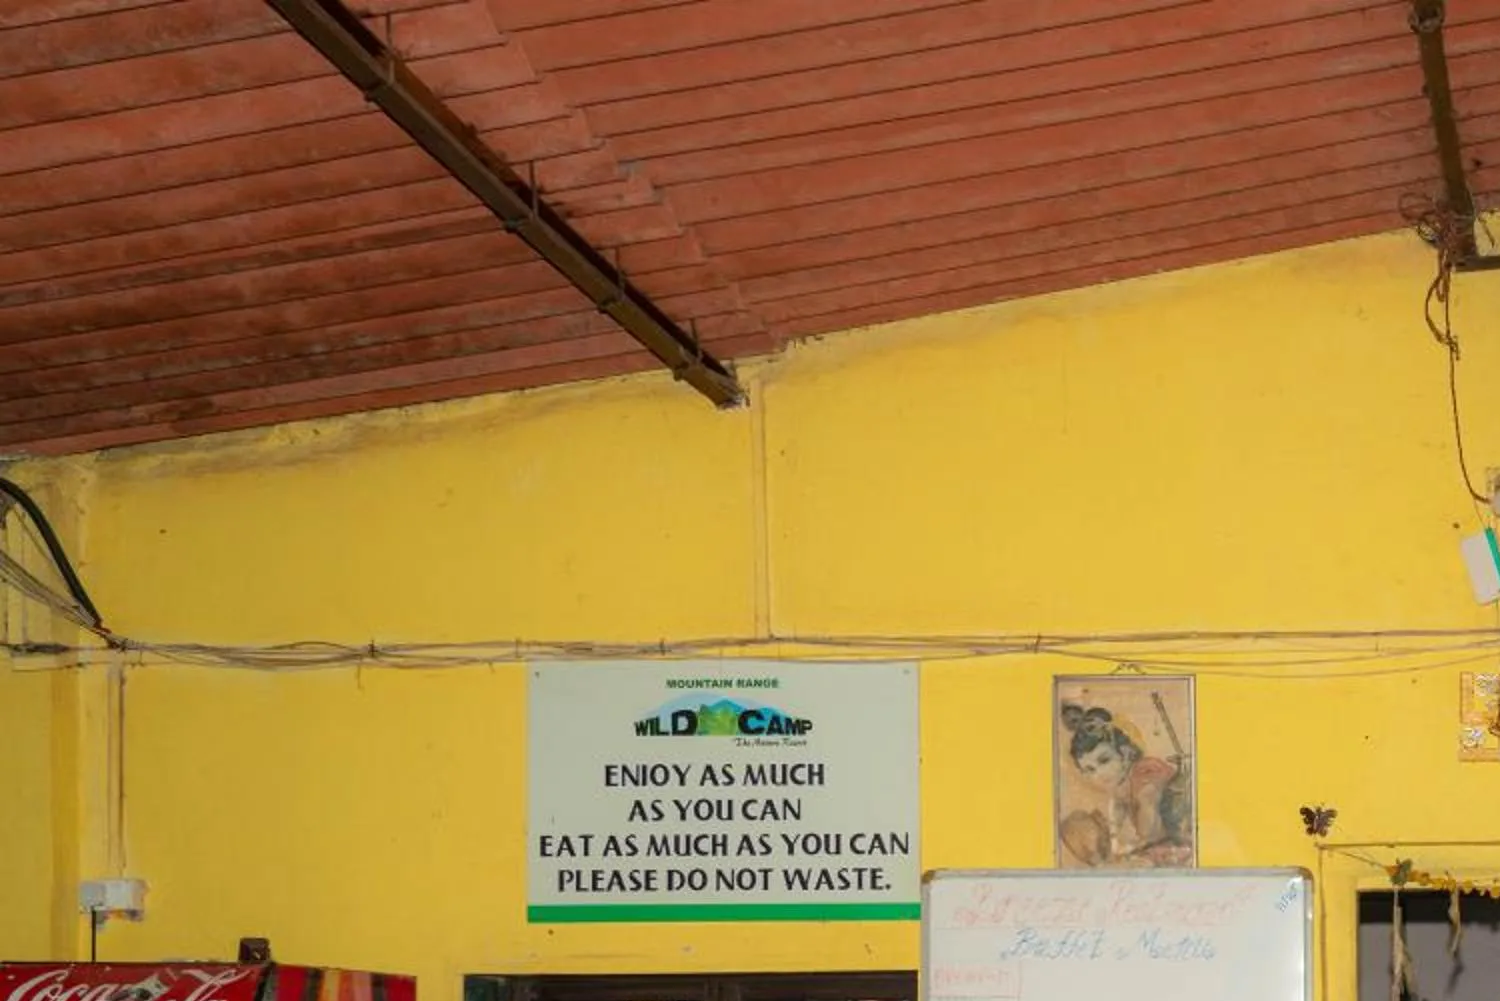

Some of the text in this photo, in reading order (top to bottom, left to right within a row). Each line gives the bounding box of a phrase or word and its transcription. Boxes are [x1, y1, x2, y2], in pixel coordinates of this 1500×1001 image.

[666, 679, 779, 688] MOUNTAIN RANGE
[635, 709, 813, 736] WILD CAMP
[699, 763, 736, 787] AS
[742, 763, 825, 787] MUCH
[628, 798, 801, 822] AS YOU CAN
[539, 832, 909, 858] EAT AS MUCH AS YOU CAN
[558, 867, 891, 893] PLEASE DO NOT WASTE.
